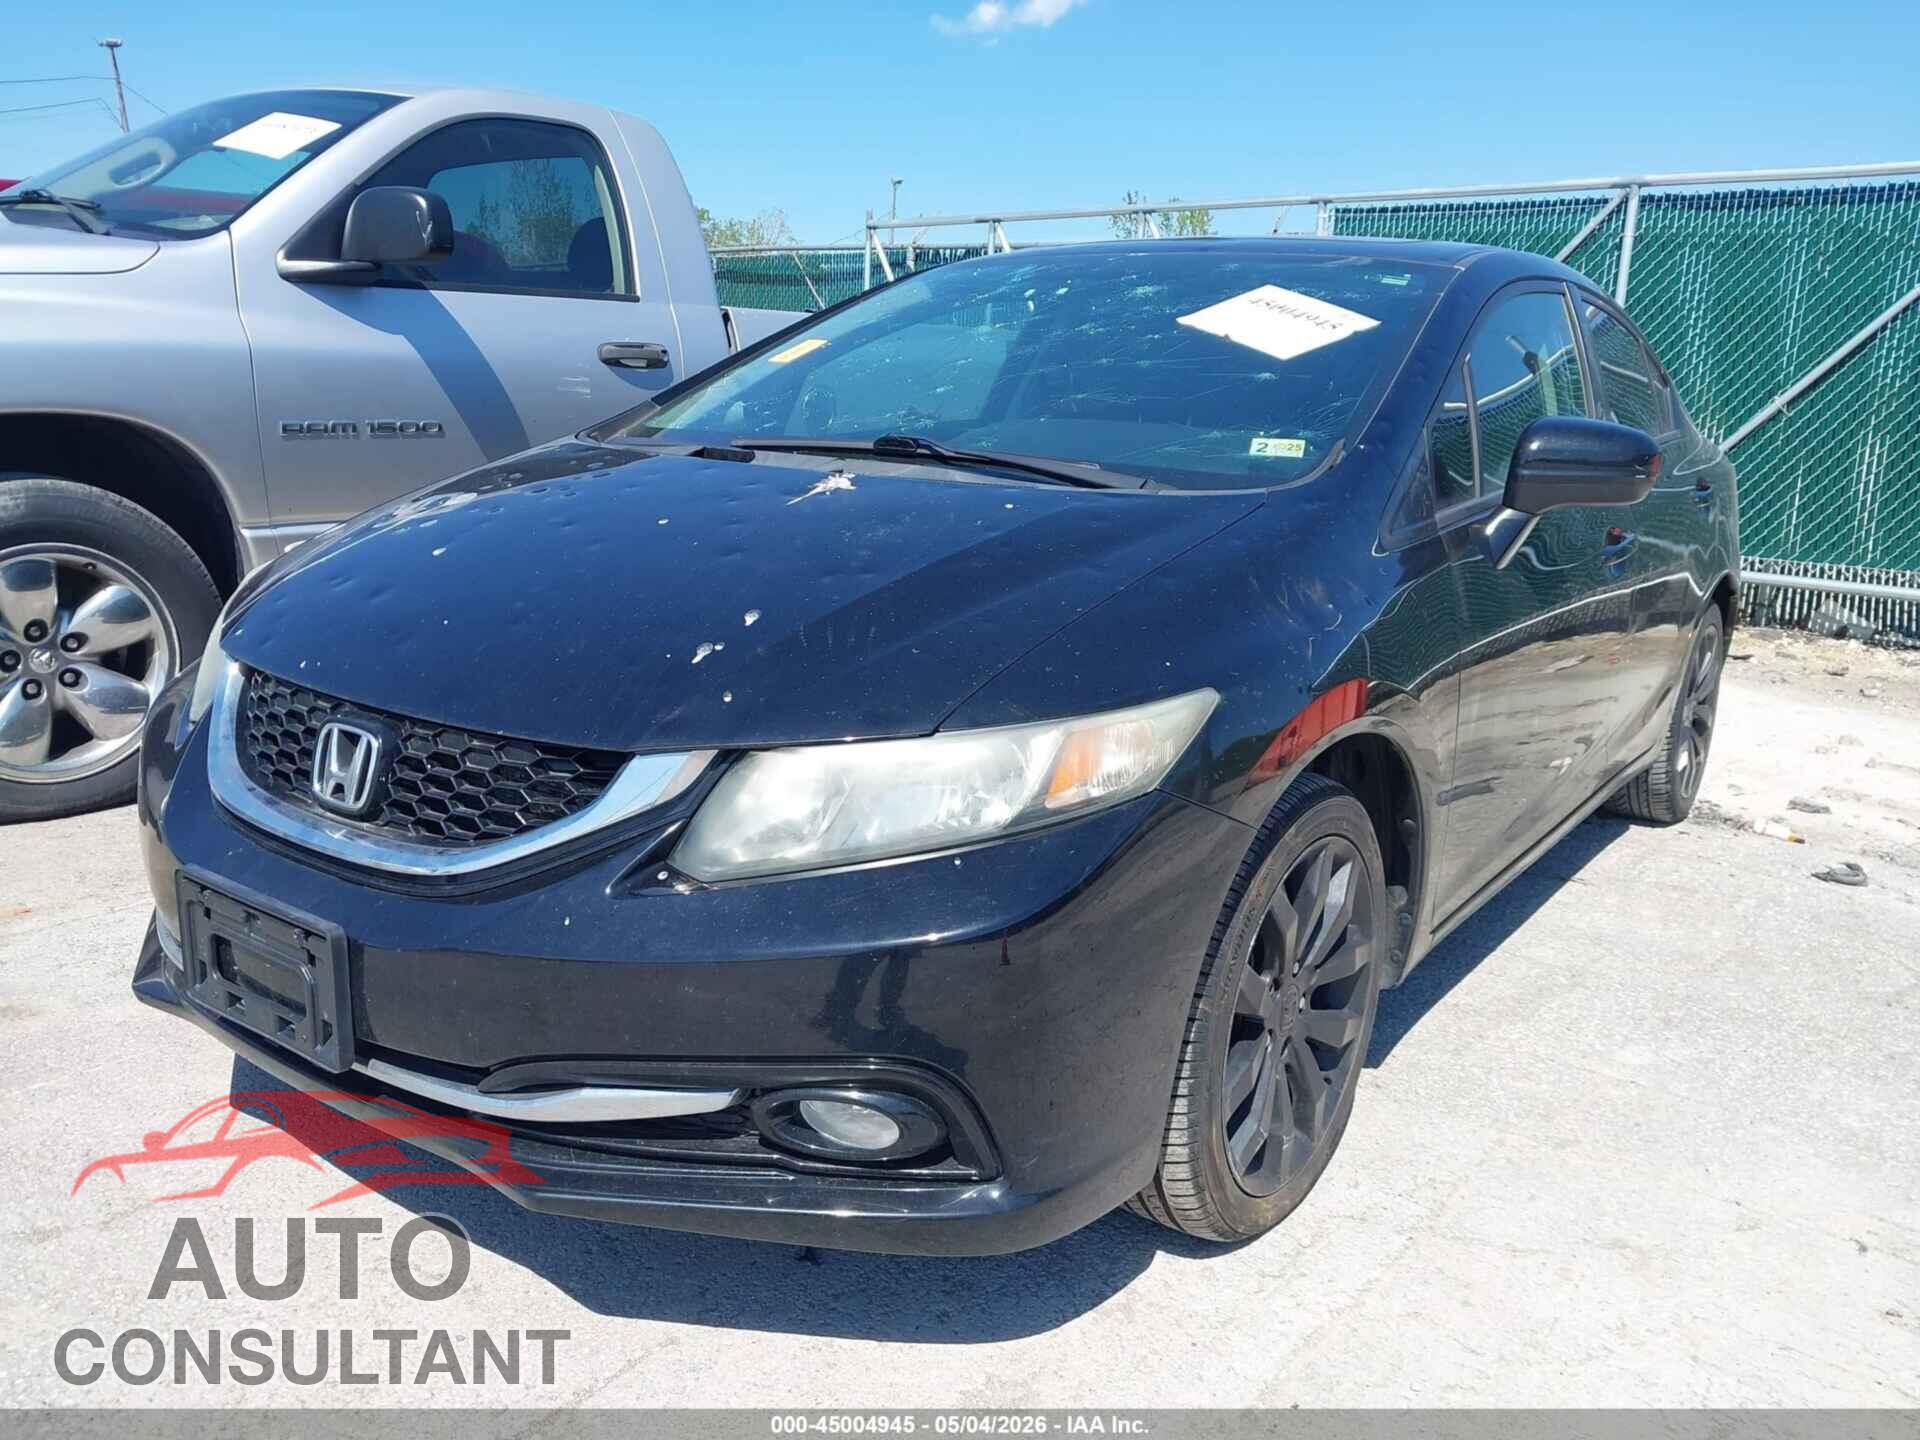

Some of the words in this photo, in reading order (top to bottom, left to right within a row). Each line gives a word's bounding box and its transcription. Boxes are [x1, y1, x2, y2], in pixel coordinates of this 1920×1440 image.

[279, 420, 359, 437] RAM
[365, 419, 444, 437] 1500
[1256, 442, 1269, 453] 2
